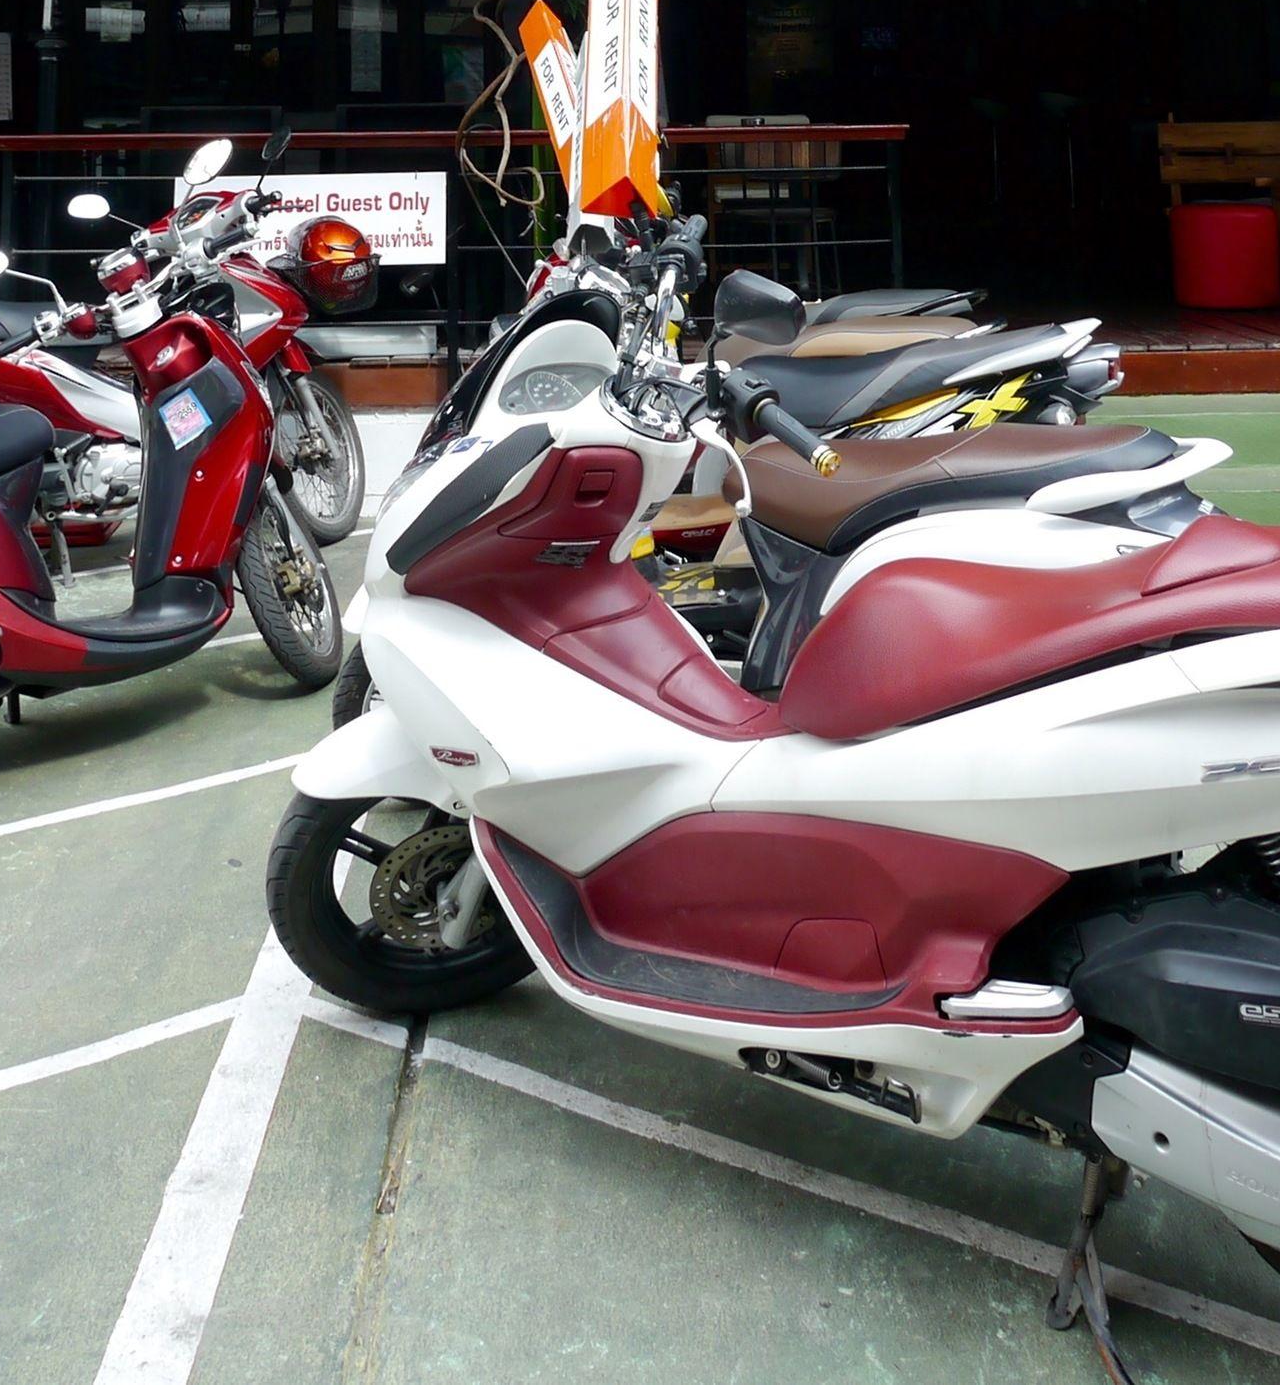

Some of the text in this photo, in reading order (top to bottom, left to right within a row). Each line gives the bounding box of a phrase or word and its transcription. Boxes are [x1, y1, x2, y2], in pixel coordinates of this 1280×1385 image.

[604, 36, 620, 95] RENT
[638, 61, 650, 110] FOR
[540, 56, 556, 89] FOR
[551, 91, 571, 132] RENT
[326, 192, 383, 212] Guest
[388, 191, 431, 215] Only
